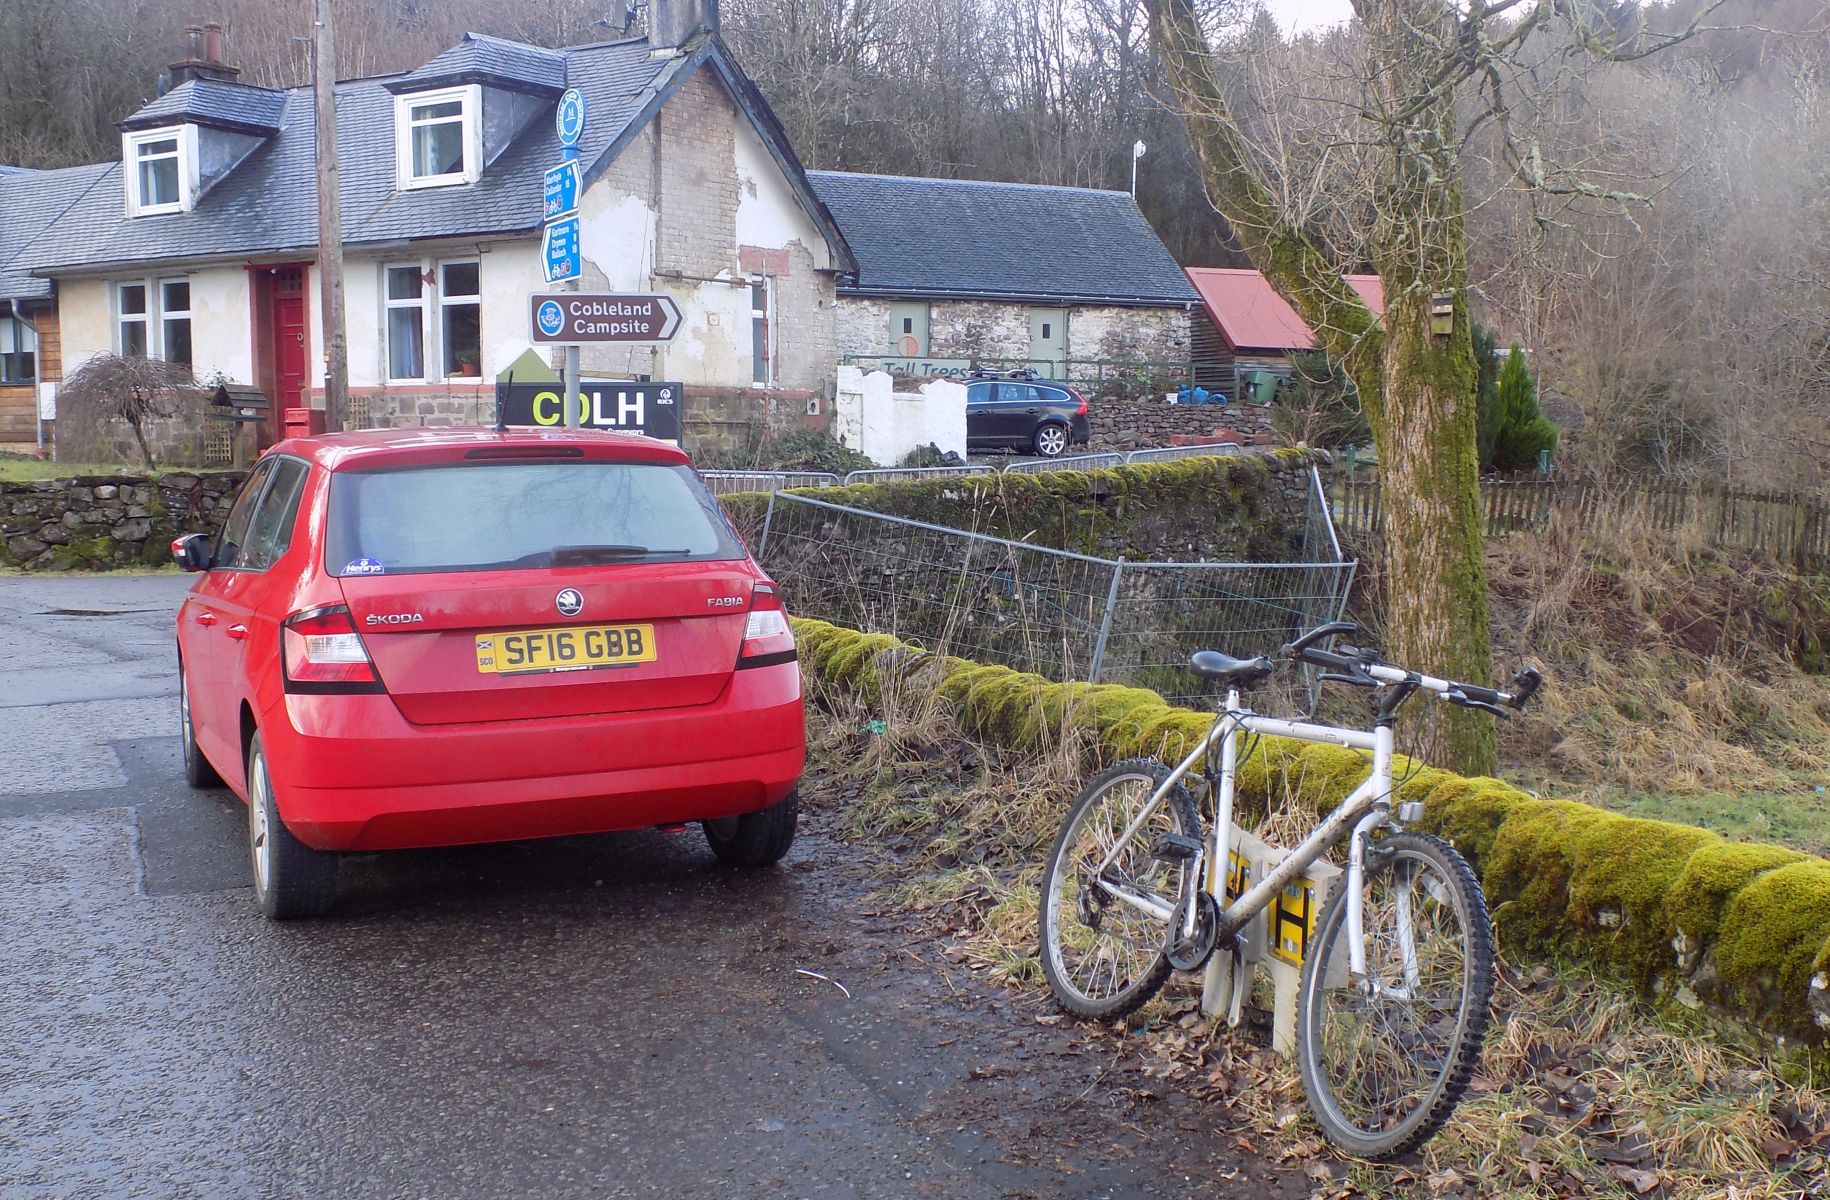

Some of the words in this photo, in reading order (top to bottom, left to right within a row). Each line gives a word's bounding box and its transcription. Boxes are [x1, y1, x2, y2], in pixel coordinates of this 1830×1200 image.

[570, 301, 652, 316] Cobleland
[574, 319, 650, 336] Campsite
[884, 362, 915, 374] Tall
[922, 363, 967, 377] Trees
[346, 563, 382, 573] Henrys
[707, 596, 744, 607] FABIA
[366, 613, 424, 625] ŠKODA
[504, 632, 576, 665] SF16
[584, 628, 644, 659] GBB
[479, 656, 493, 666] SCO
[1275, 886, 1309, 960] H
